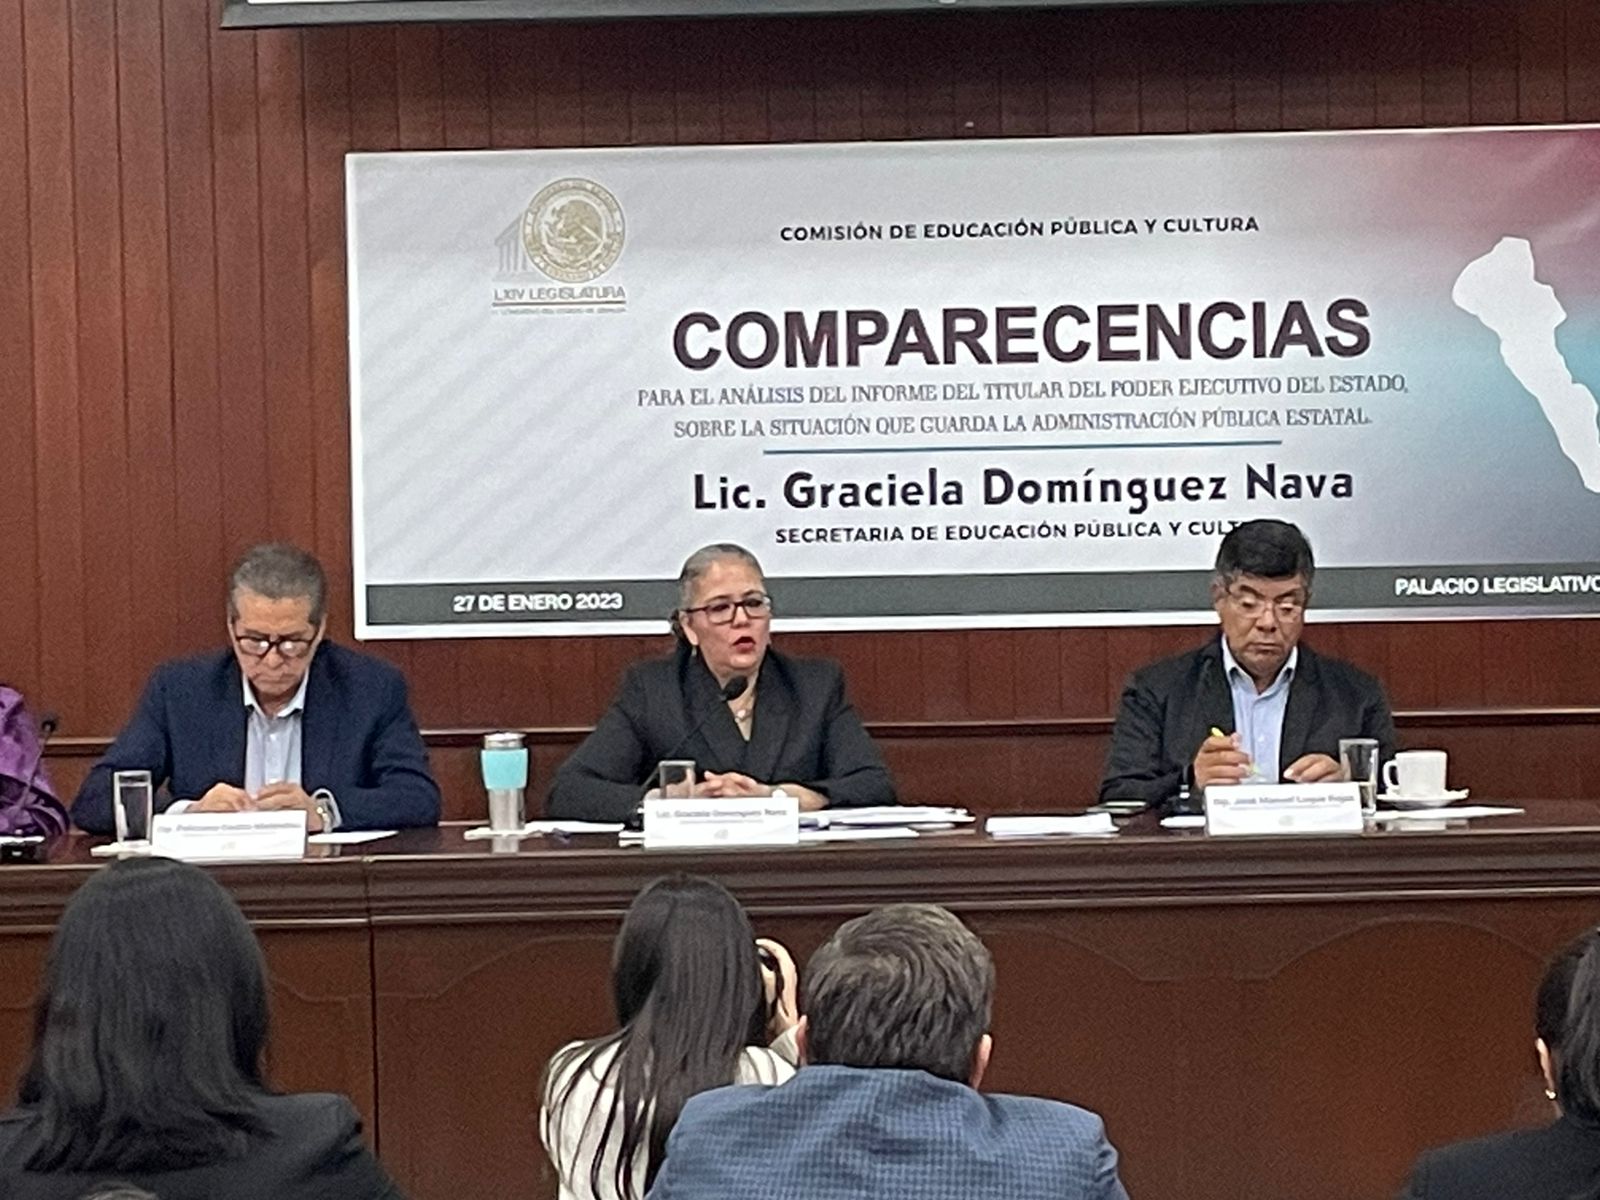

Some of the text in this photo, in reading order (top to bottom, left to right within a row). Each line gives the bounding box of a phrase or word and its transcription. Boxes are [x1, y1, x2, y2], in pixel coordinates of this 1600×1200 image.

[780, 214, 1260, 242] COMISIÓN DE EDUCACIÓN PÚBLICA Y CULTURA
[493, 285, 626, 301] LXIV LEGISLATURA
[673, 298, 1371, 370] COMPARECENCIAS
[637, 374, 1409, 407] PARA EL ANÁLISIS DEL INFORME DEL TITULAR DEL PODER EJECUTIVO DEL ESTADO,
[673, 419, 736, 438] SOBRE
[740, 419, 766, 437] LA
[769, 413, 871, 437] SITUACIÓN
[875, 416, 916, 436] QUE
[920, 414, 999, 434] GUARDA
[1003, 414, 1028, 433] LA
[1031, 406, 1197, 432] ADMINISTRACIÓN
[1201, 406, 1281, 428] PÚBLICA
[694, 462, 1353, 515] Lic. Graciela Domínguez Nava
[775, 519, 1241, 544] SECRETARIA DE EDUCACIÓN PÚBLICA Y CULT
[1395, 574, 1600, 596] PALACIO LEGISLATIVO
[453, 592, 624, 612] 27 DE ENERO 2023
